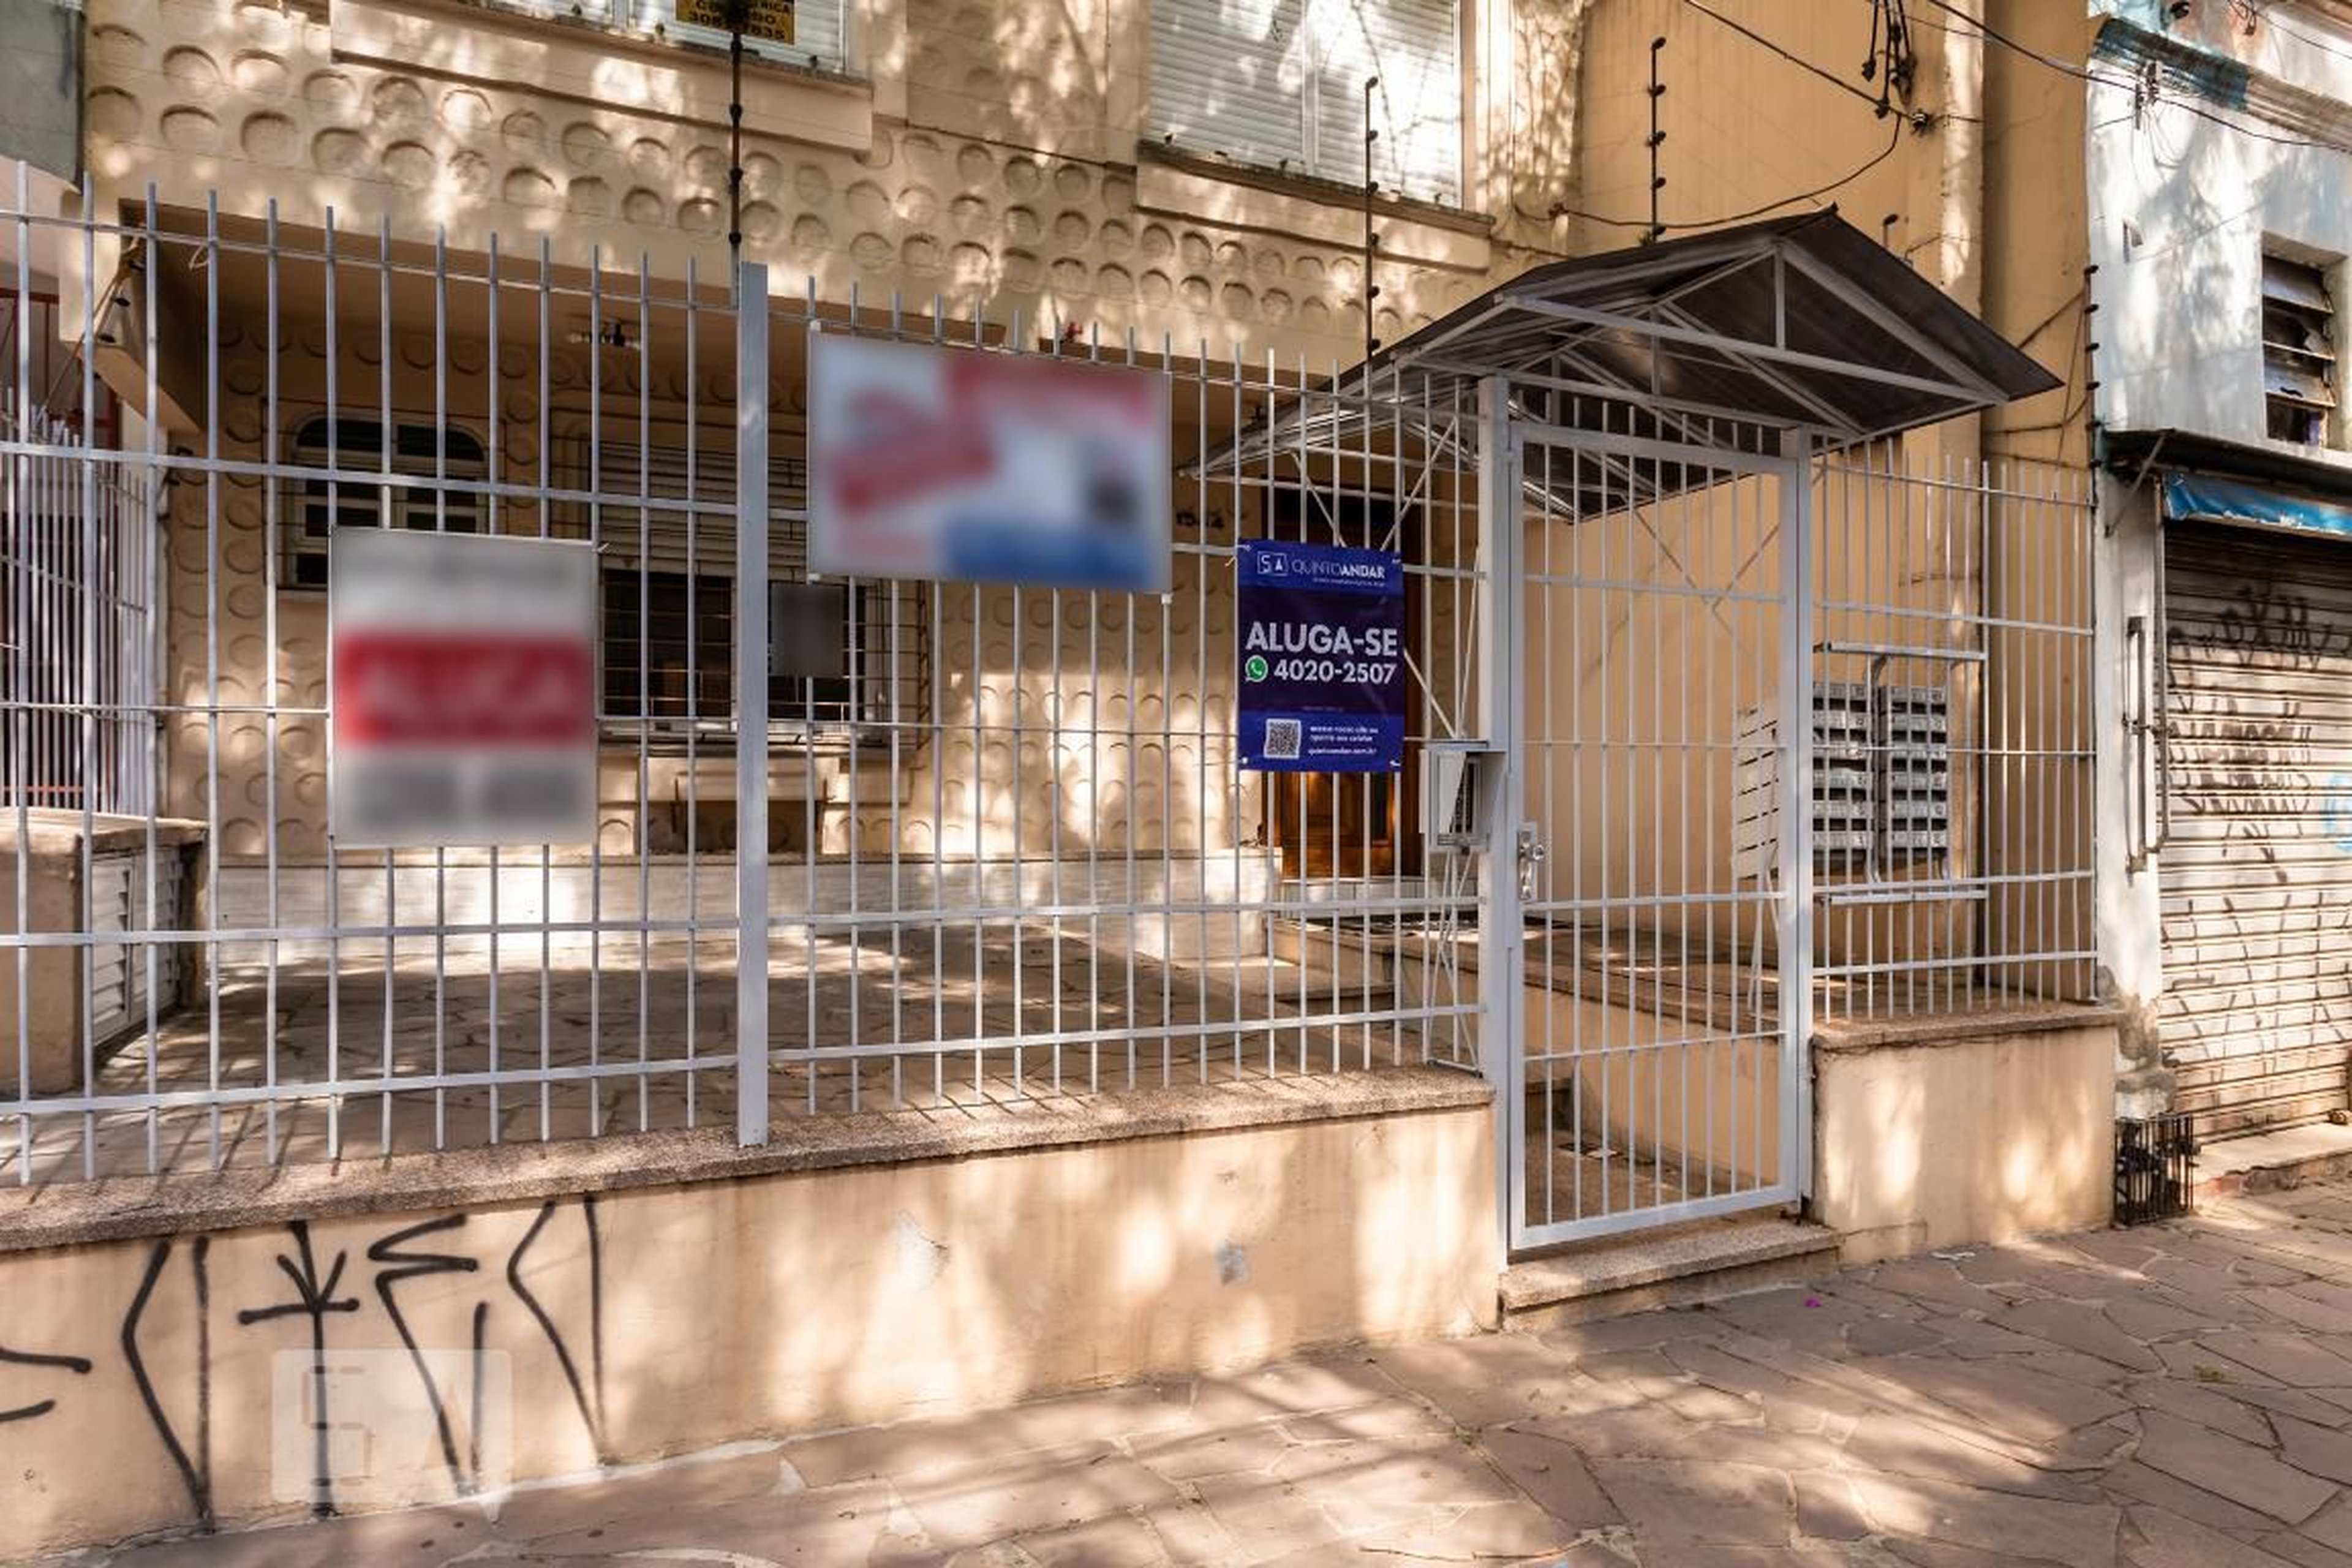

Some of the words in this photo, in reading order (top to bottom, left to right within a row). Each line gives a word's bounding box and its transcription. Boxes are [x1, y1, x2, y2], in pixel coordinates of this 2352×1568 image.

[1291, 559, 1385, 579] QUINTOANDAR
[1245, 621, 1398, 657] ALUGA-SE
[1274, 658, 1397, 684] 4020-2507
